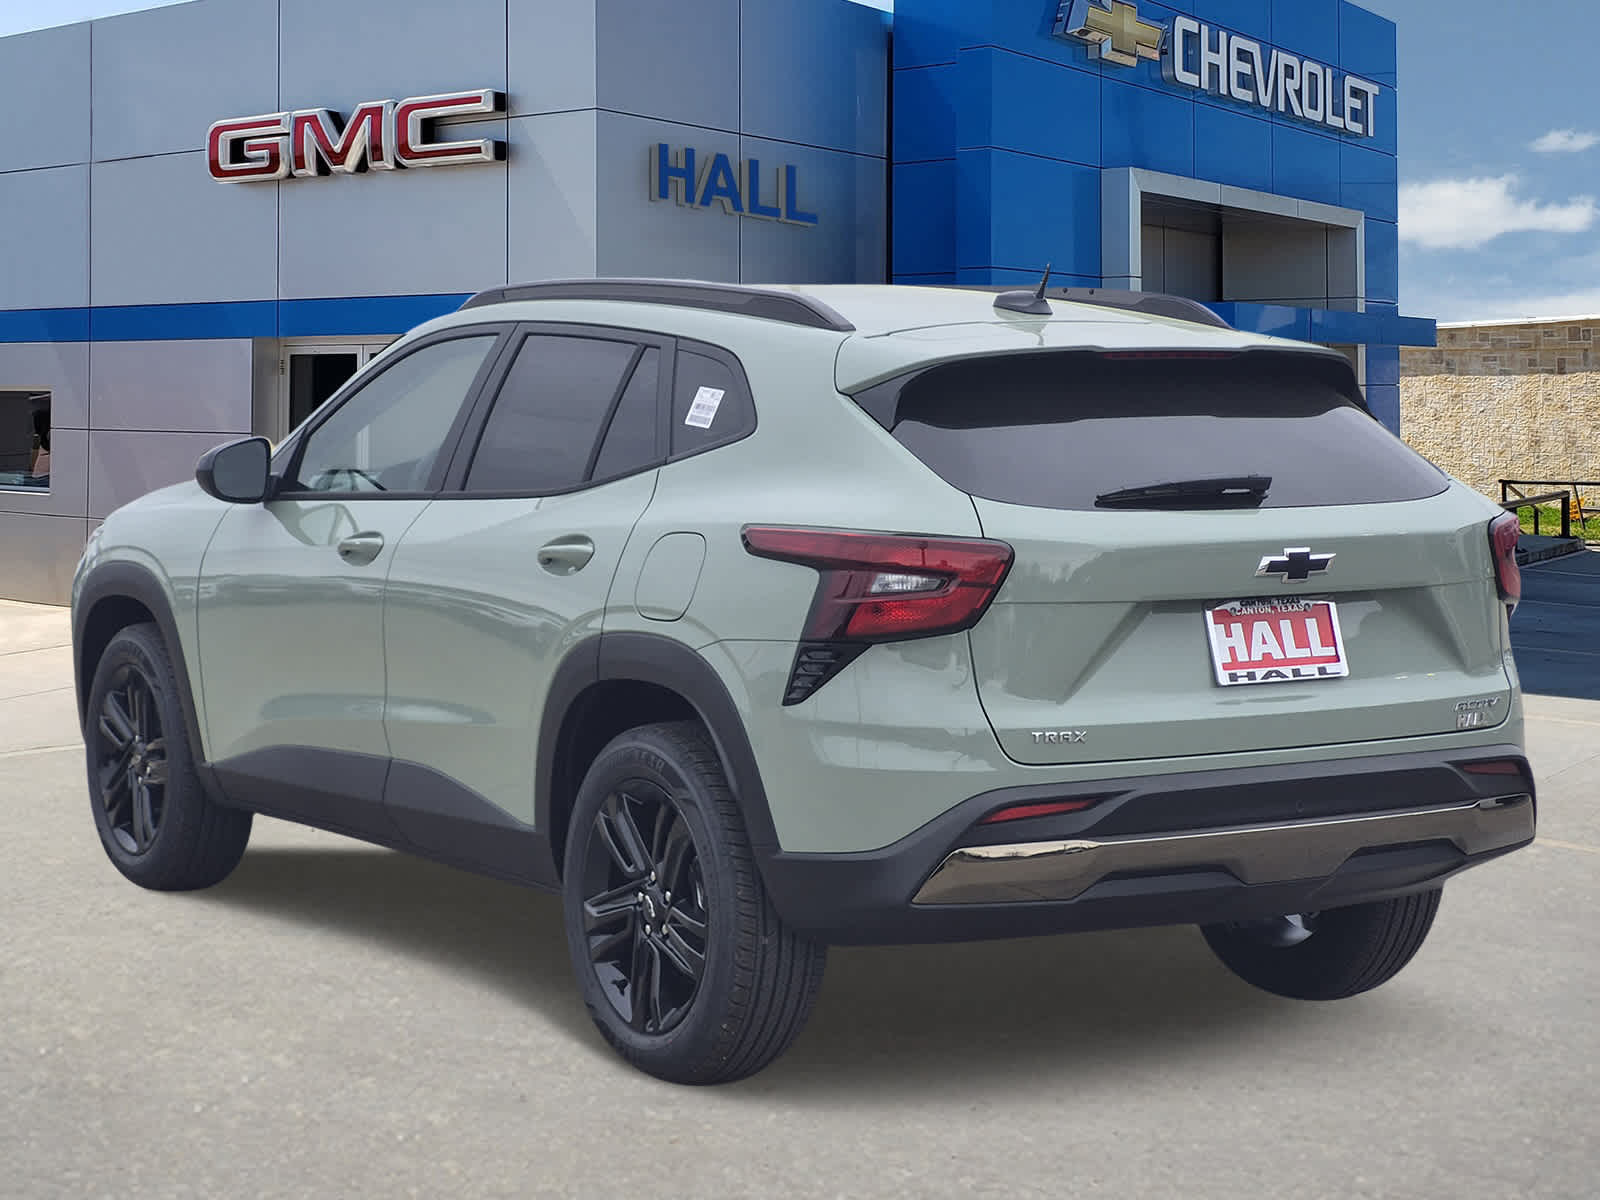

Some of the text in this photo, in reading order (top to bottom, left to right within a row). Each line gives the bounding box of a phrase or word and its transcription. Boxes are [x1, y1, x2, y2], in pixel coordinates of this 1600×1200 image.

[1173, 15, 1380, 137] CHEVROLET
[208, 88, 506, 184] GMC
[651, 142, 819, 227] HALL
[1277, 603, 1305, 613] TEXAS
[1213, 617, 1337, 663] HALL
[1228, 665, 1341, 683] HALL
[1031, 730, 1088, 744] TRAX
